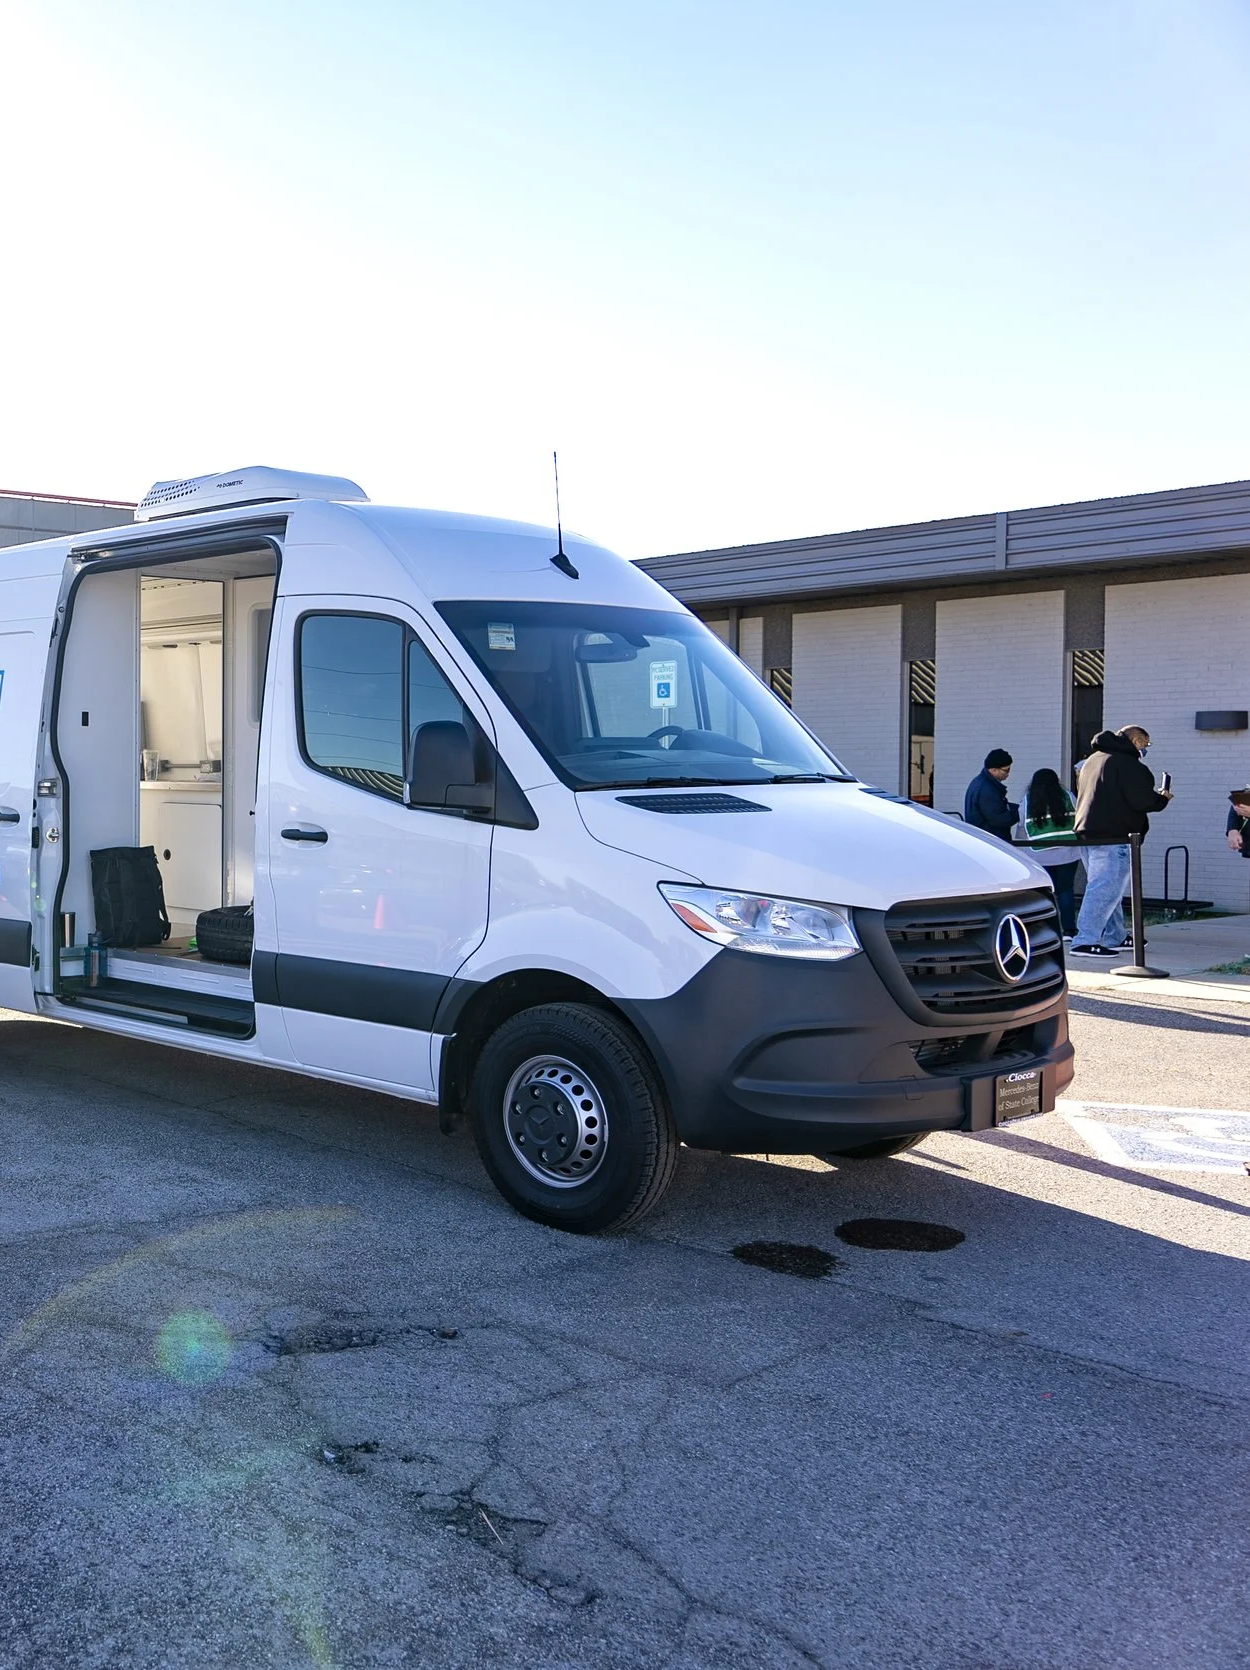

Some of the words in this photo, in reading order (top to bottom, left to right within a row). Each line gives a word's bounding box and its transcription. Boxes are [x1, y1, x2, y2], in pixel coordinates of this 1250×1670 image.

[223, 480, 244, 488] DOMETIC
[1000, 1083, 1039, 1097] Mercedes-Benz
[999, 1101, 1005, 1111] of
[1005, 1100, 1021, 1110] State
[1021, 1096, 1039, 1106] College
